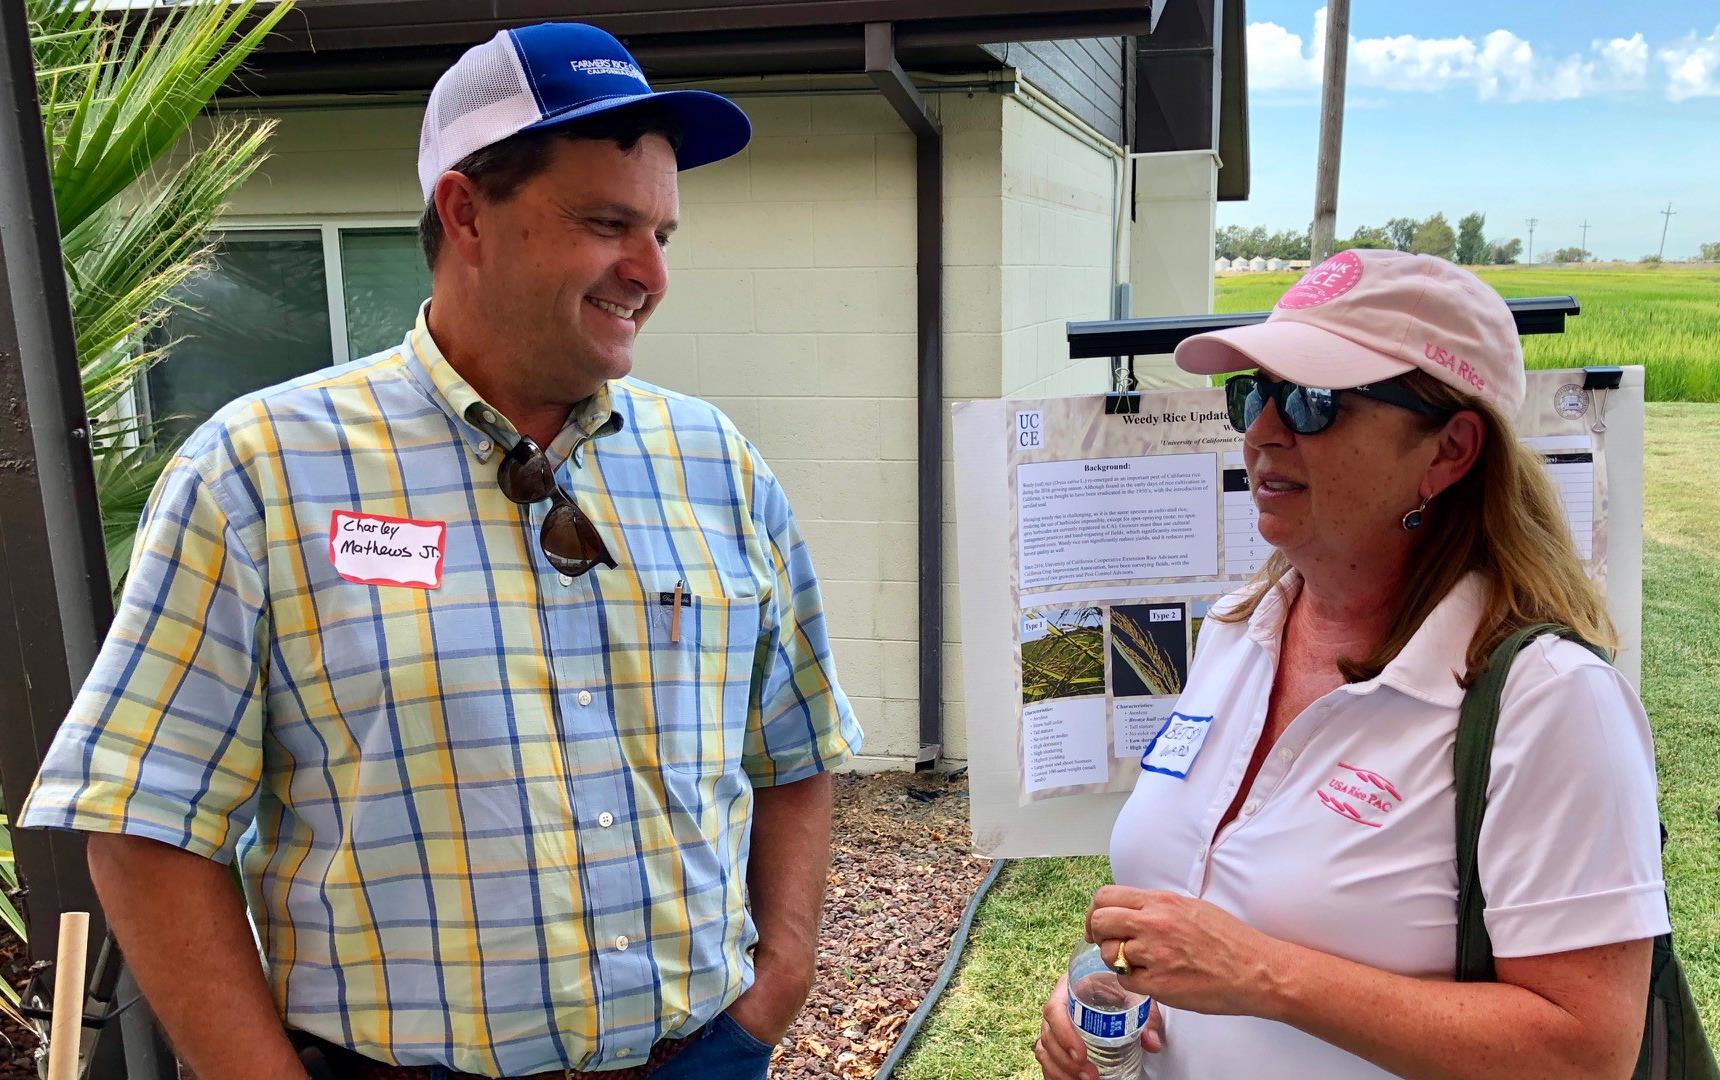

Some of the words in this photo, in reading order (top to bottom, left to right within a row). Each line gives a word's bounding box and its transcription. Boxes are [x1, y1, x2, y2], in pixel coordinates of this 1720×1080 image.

[1424, 338, 1456, 371] USA
[1456, 360, 1486, 391] Rice
[1019, 414, 1039, 429] UC
[1122, 414, 1159, 426] Weedy
[1163, 413, 1187, 423] Rice
[1020, 431, 1039, 446] CE
[1084, 463, 1131, 472] Background:
[343, 519, 400, 540] Charley
[340, 540, 412, 557] Mathews
[1025, 623, 1038, 631] Type
[1329, 779, 1348, 792] USA
[1347, 786, 1366, 800] Rice
[1367, 794, 1392, 813] PAC
